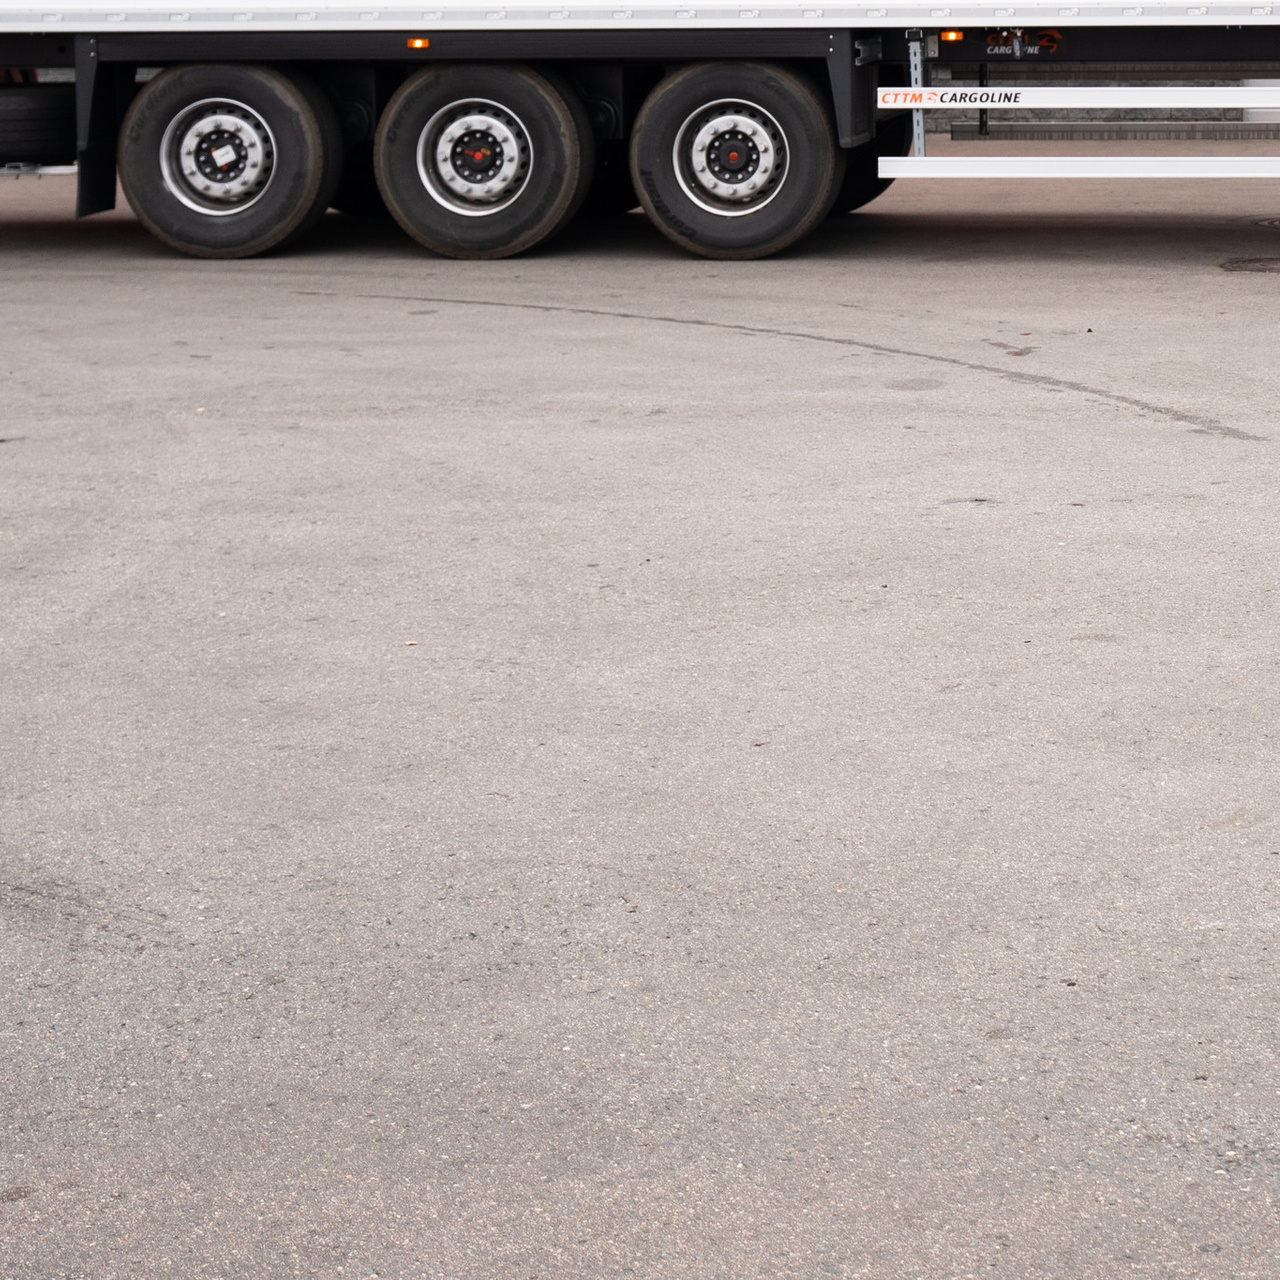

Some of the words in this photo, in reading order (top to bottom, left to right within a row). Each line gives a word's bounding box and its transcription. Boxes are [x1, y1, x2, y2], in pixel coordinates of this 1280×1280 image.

[986, 45, 1040, 54] CARGNE
[881, 93, 923, 104] CTTM
[939, 92, 1021, 104] CARGOLINE
